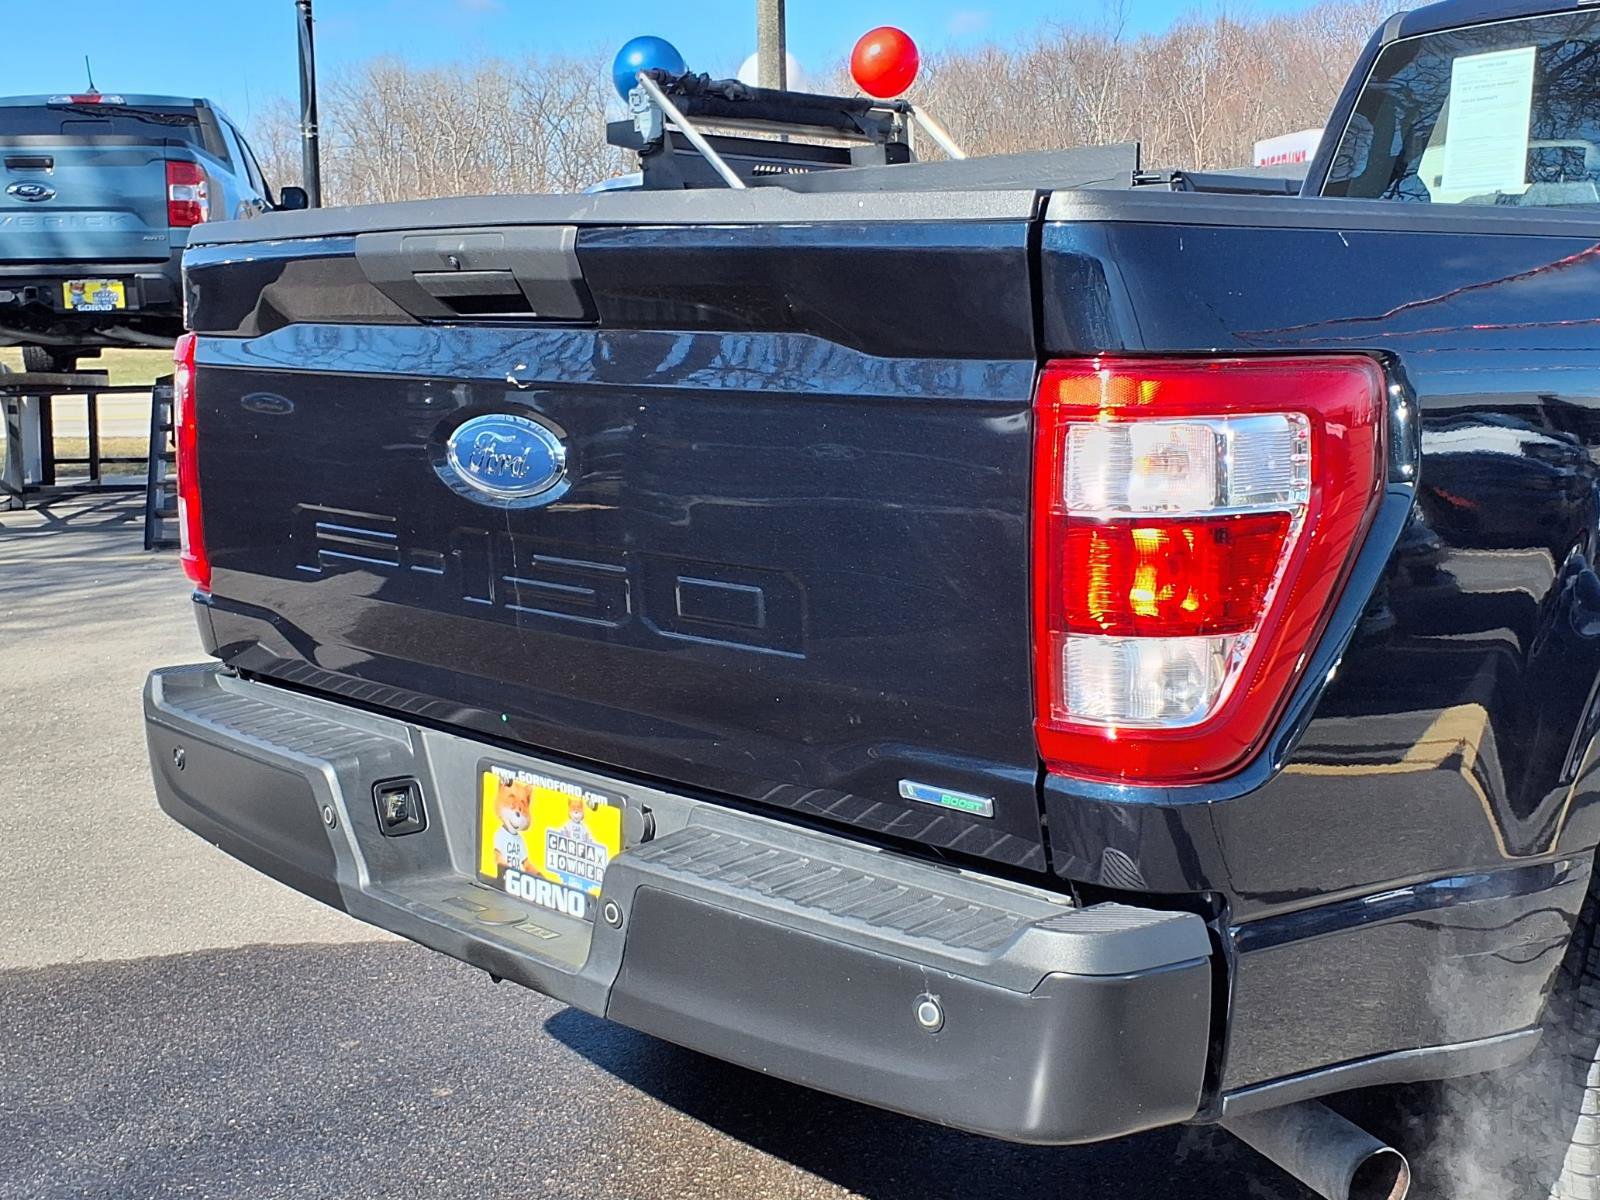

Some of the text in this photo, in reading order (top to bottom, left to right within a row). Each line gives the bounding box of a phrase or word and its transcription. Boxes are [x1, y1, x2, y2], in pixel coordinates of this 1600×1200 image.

[469, 431, 531, 478] Ford
[296, 501, 806, 659] F-150
[548, 834, 605, 865] CARFAX
[505, 868, 586, 918] GORNO
